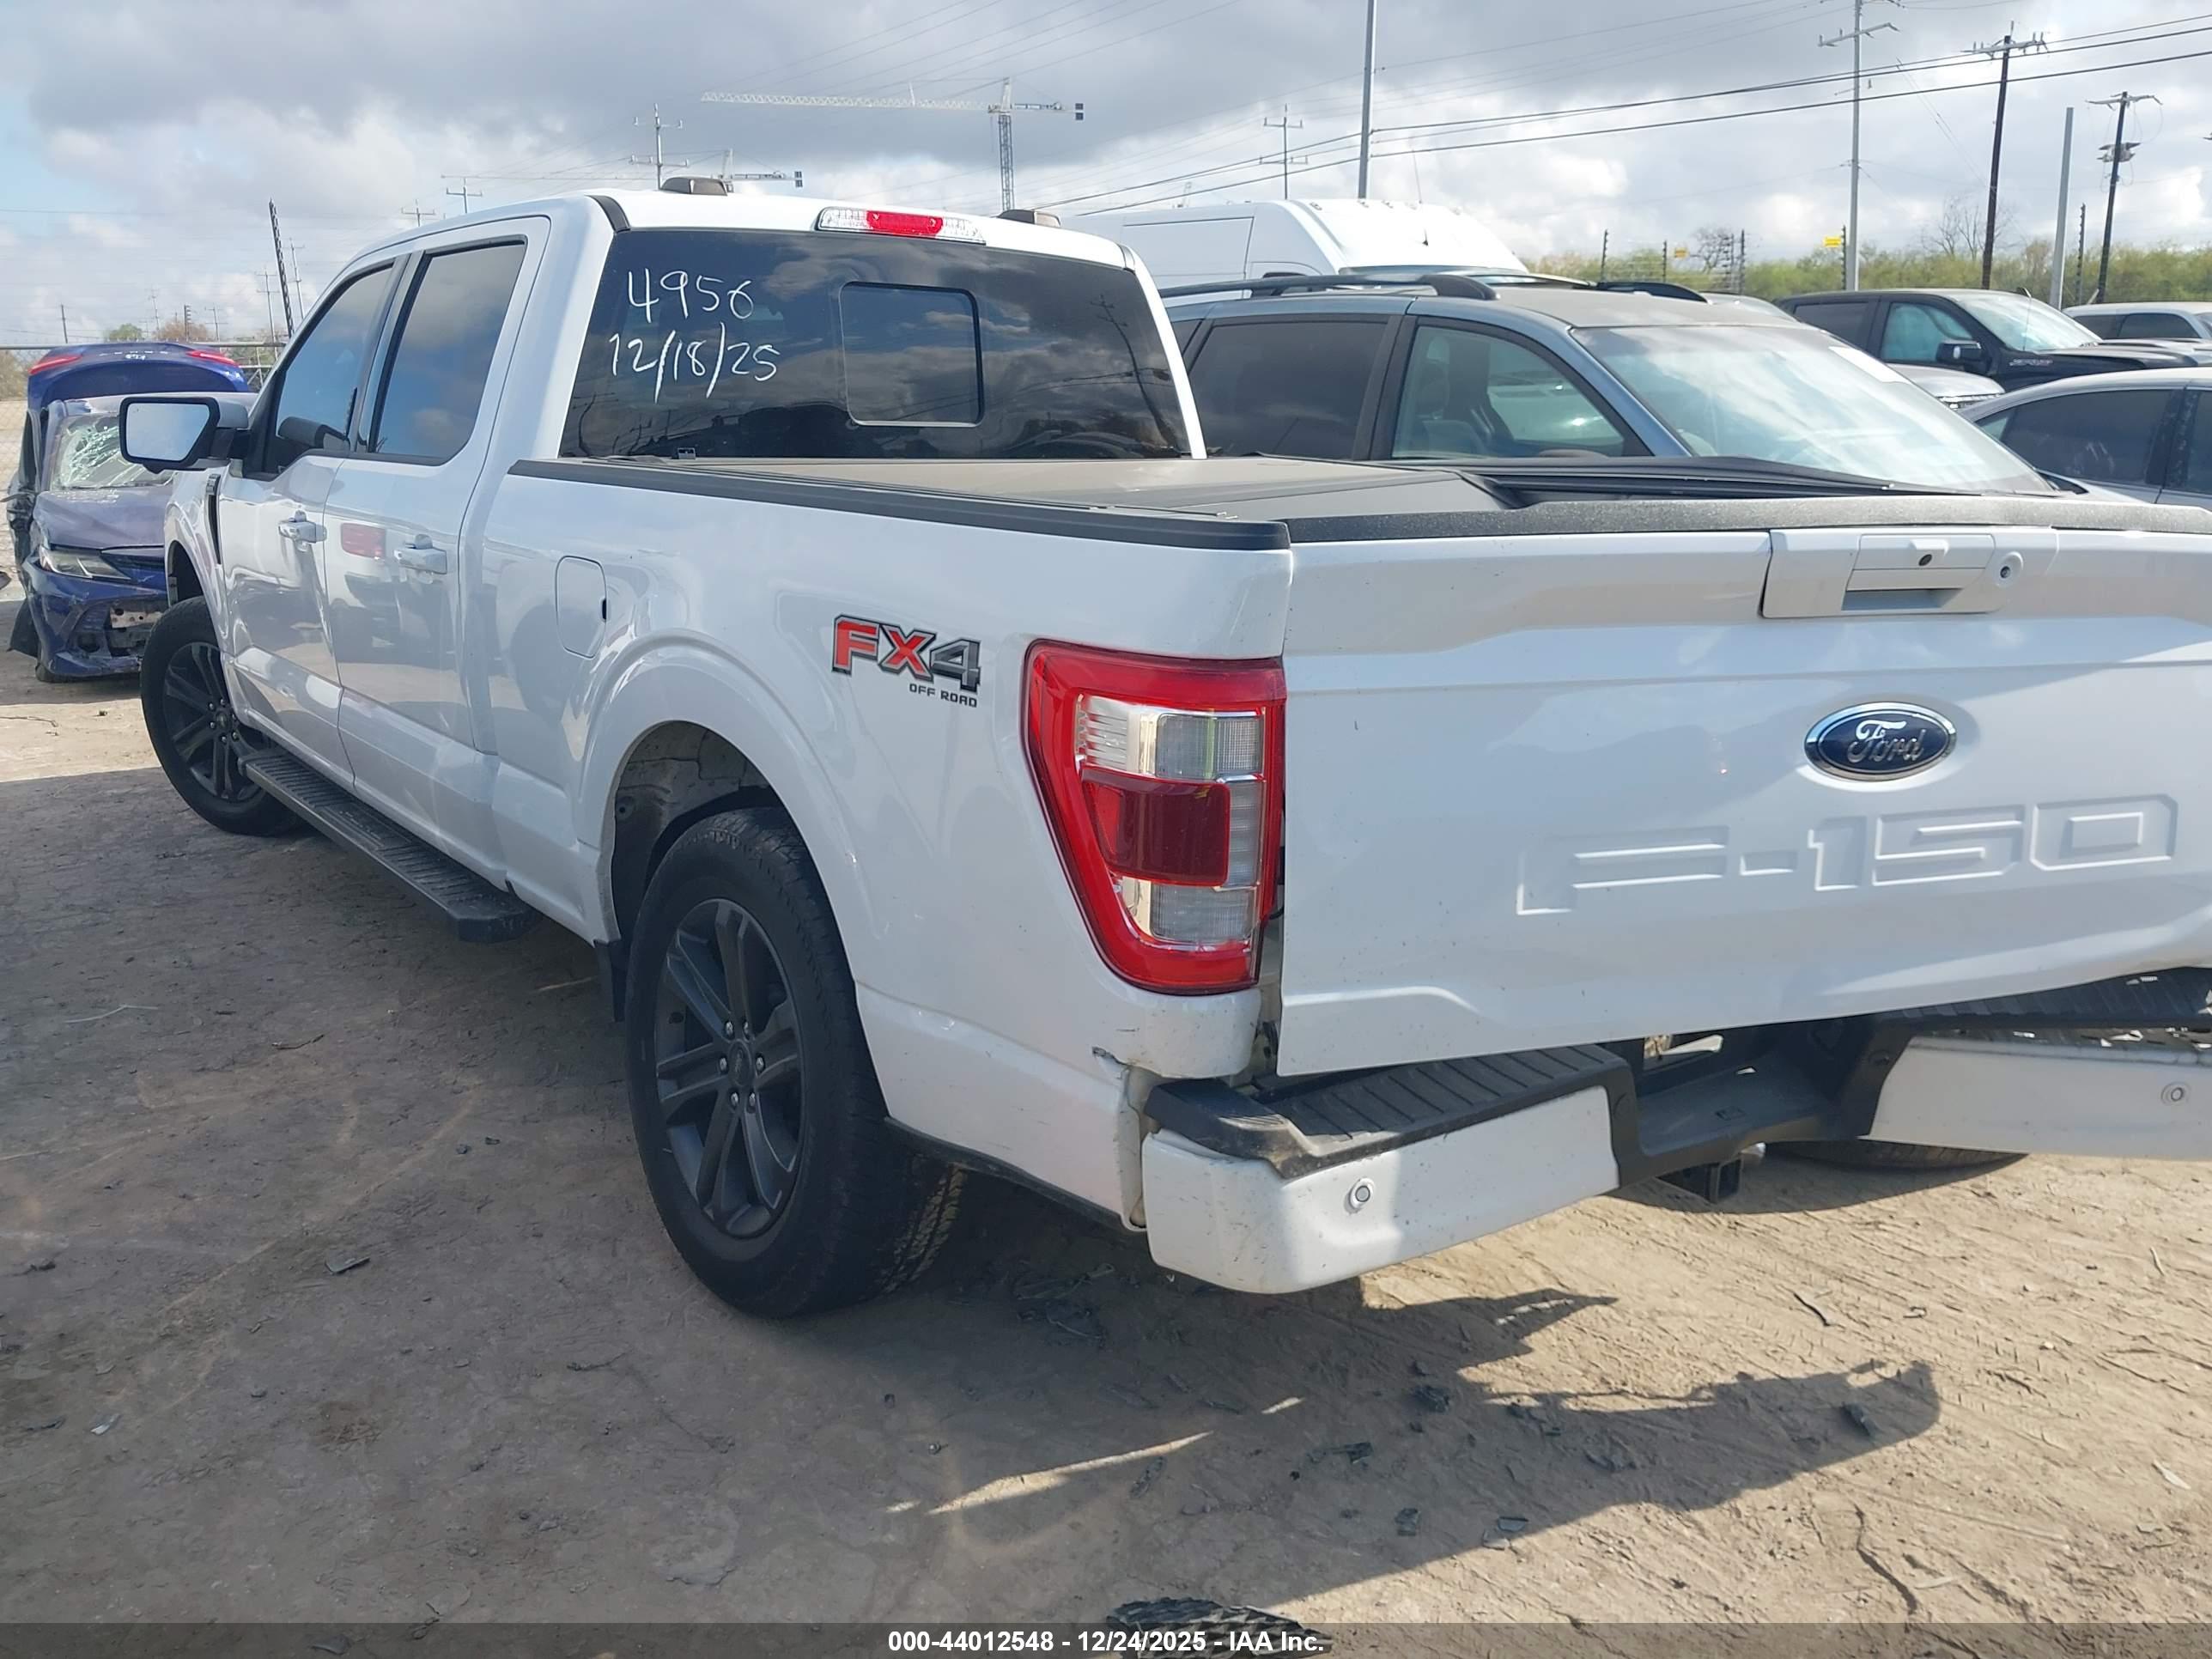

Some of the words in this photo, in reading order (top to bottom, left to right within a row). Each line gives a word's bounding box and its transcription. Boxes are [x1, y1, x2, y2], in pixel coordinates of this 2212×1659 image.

[628, 268, 754, 323] 4956
[609, 321, 781, 404] 12/18/25
[831, 613, 981, 695] FX4
[908, 684, 936, 696] OFF
[940, 690, 977, 708] ROAD
[1847, 719, 1926, 763] Ford
[1516, 794, 2179, 915] F-150
